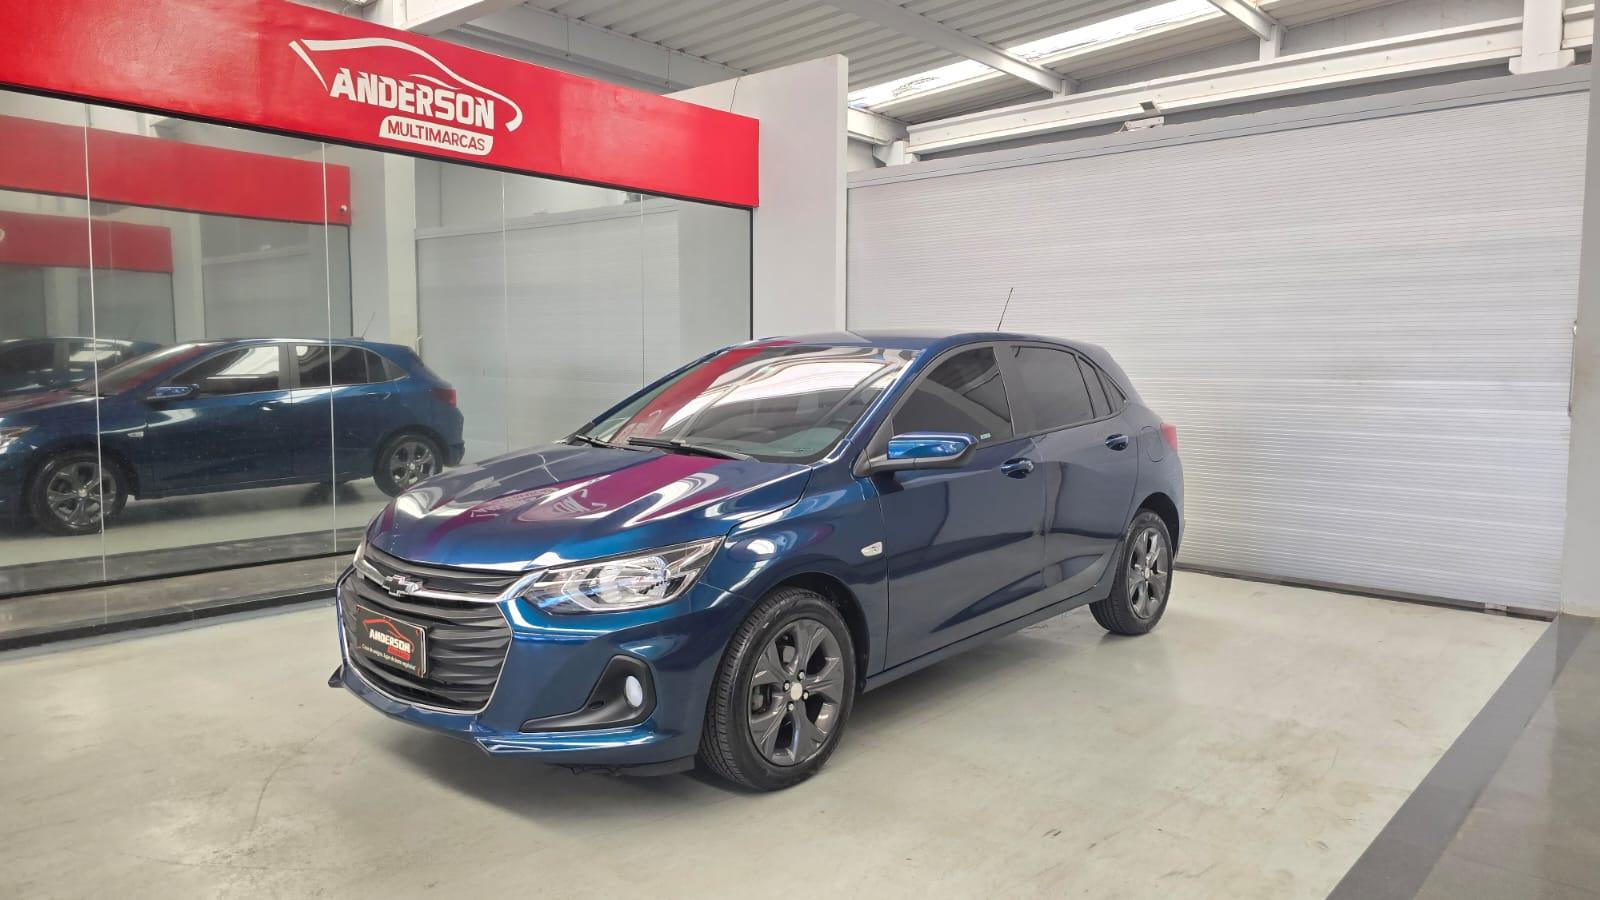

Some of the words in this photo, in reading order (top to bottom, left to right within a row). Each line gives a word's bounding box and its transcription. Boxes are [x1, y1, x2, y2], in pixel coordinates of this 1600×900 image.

[329, 68, 495, 130] ANDERSON
[387, 119, 486, 151] MULTIMARCAS
[369, 628, 411, 654] ANDERSON
